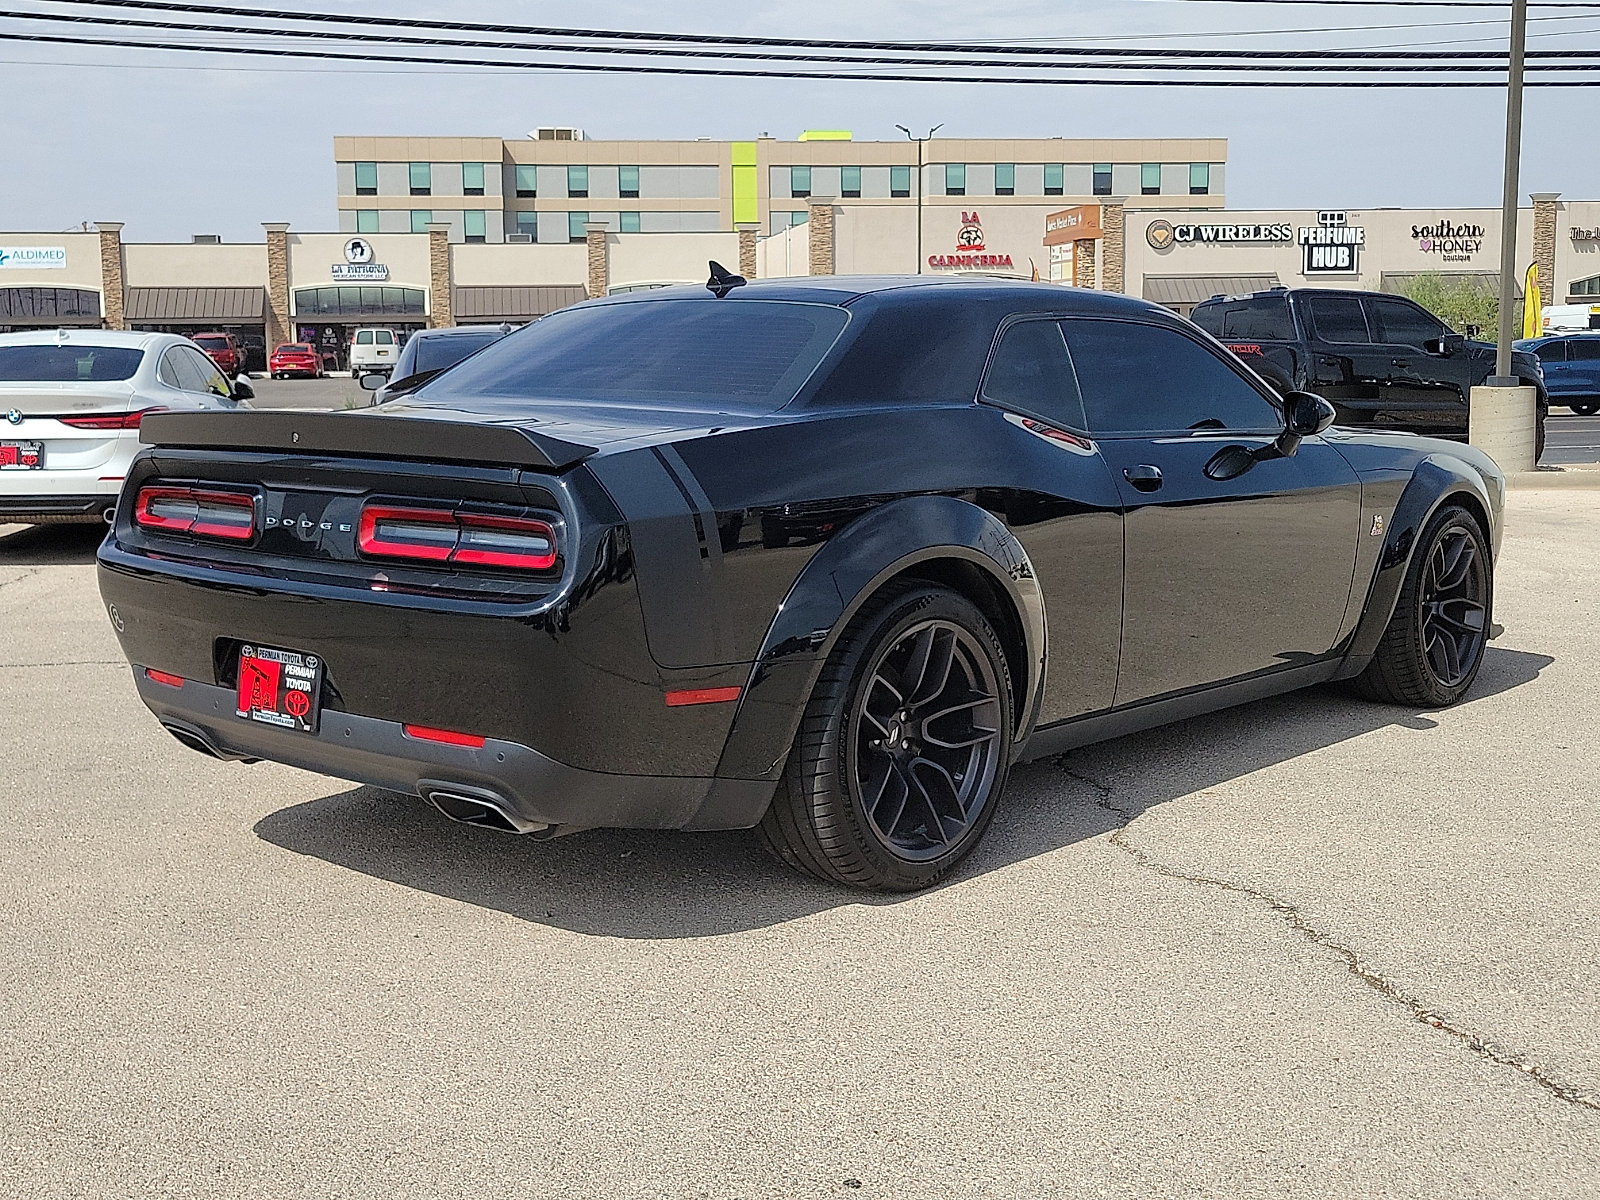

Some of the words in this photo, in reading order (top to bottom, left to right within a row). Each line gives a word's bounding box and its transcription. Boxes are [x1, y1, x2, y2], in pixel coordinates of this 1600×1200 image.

[961, 211, 980, 224] LA
[1174, 224, 1196, 241] CJ
[1199, 223, 1293, 241] WIRELESS
[1299, 227, 1364, 245] PERFUME
[1411, 219, 1485, 239] southern
[1570, 226, 1593, 240] The
[1432, 239, 1482, 254] HONEY
[13, 250, 65, 260] ALDIMED
[928, 254, 1014, 268] CARNICERIA
[1311, 246, 1350, 268] HUB
[1442, 254, 1471, 263] boutique
[331, 266, 343, 274] LA
[347, 265, 386, 274] PATRONA
[266, 517, 352, 532] DODGE
[258, 648, 281, 662] PERMIAN
[285, 664, 316, 680] PERMIAN
[286, 677, 312, 692] TOYOTA
